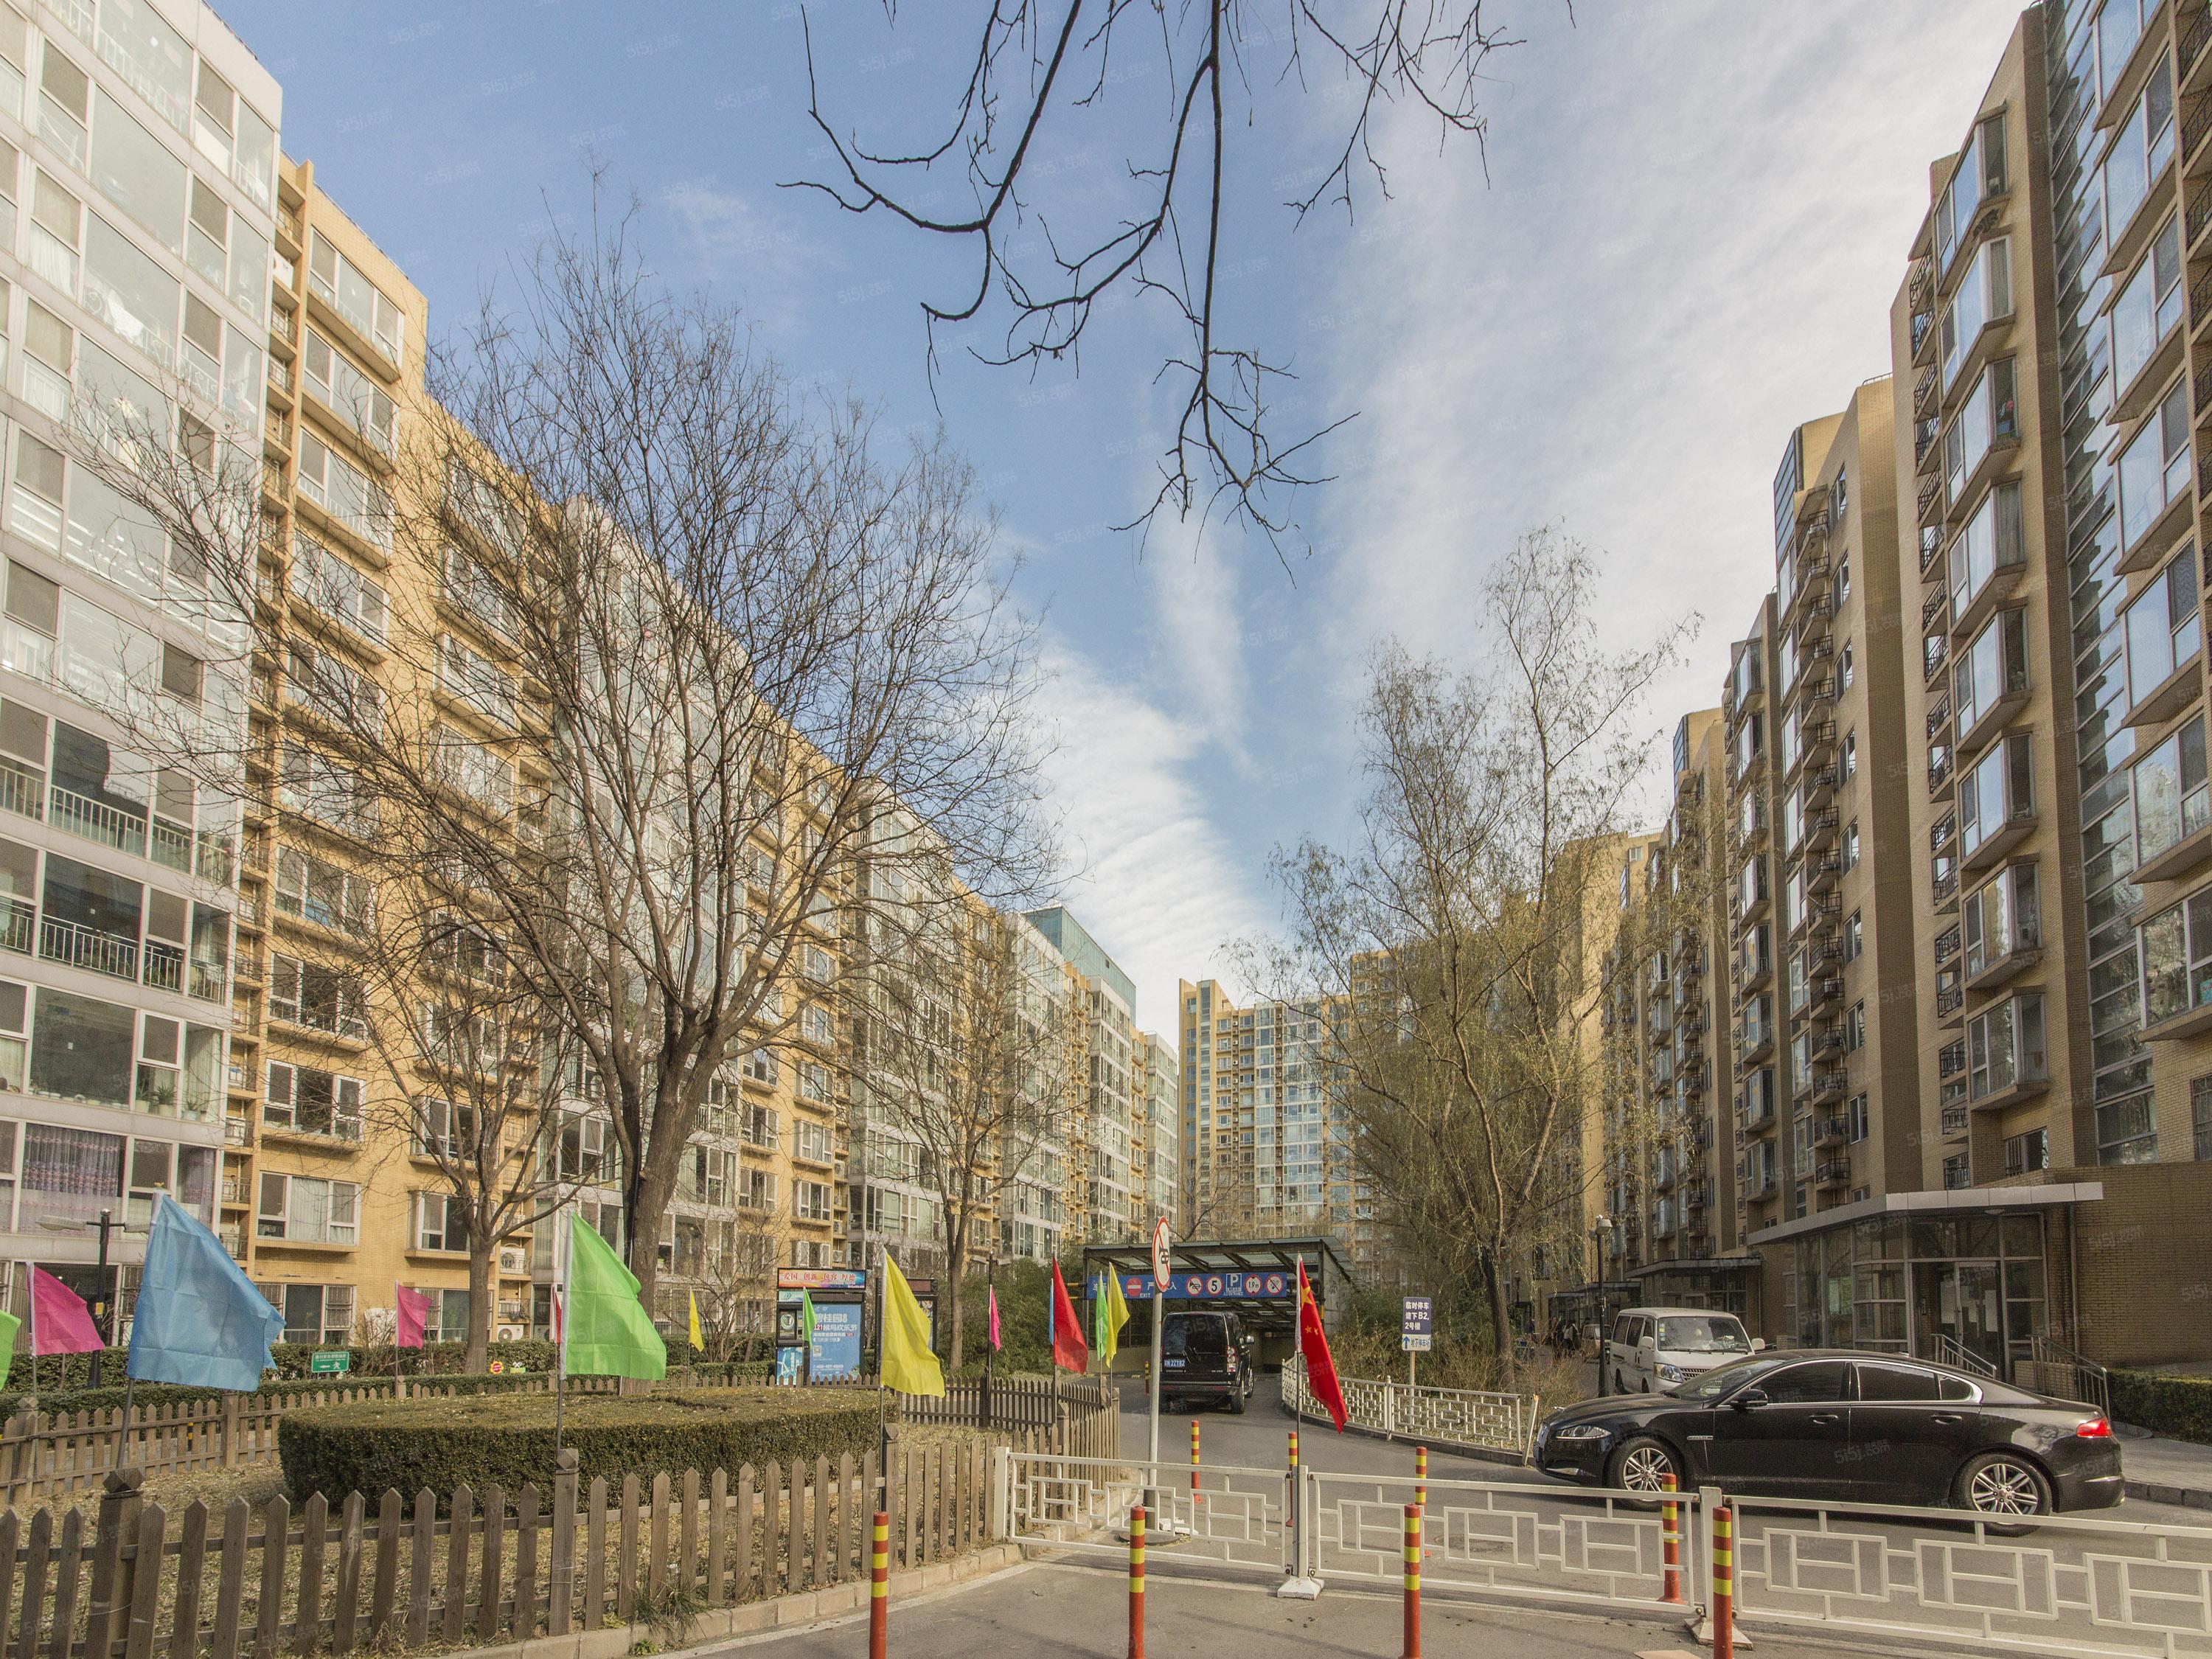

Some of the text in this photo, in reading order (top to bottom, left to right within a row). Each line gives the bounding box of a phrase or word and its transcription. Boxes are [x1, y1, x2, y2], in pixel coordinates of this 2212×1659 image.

[783, 1273, 798, 1281] 爱国
[804, 1273, 818, 1281] 创新
[823, 1273, 838, 1281] 包容
[1211, 1280, 1217, 1292] 5
[1405, 1301, 1430, 1310] 临时停车
[1405, 1321, 1421, 1331] 2号楼
